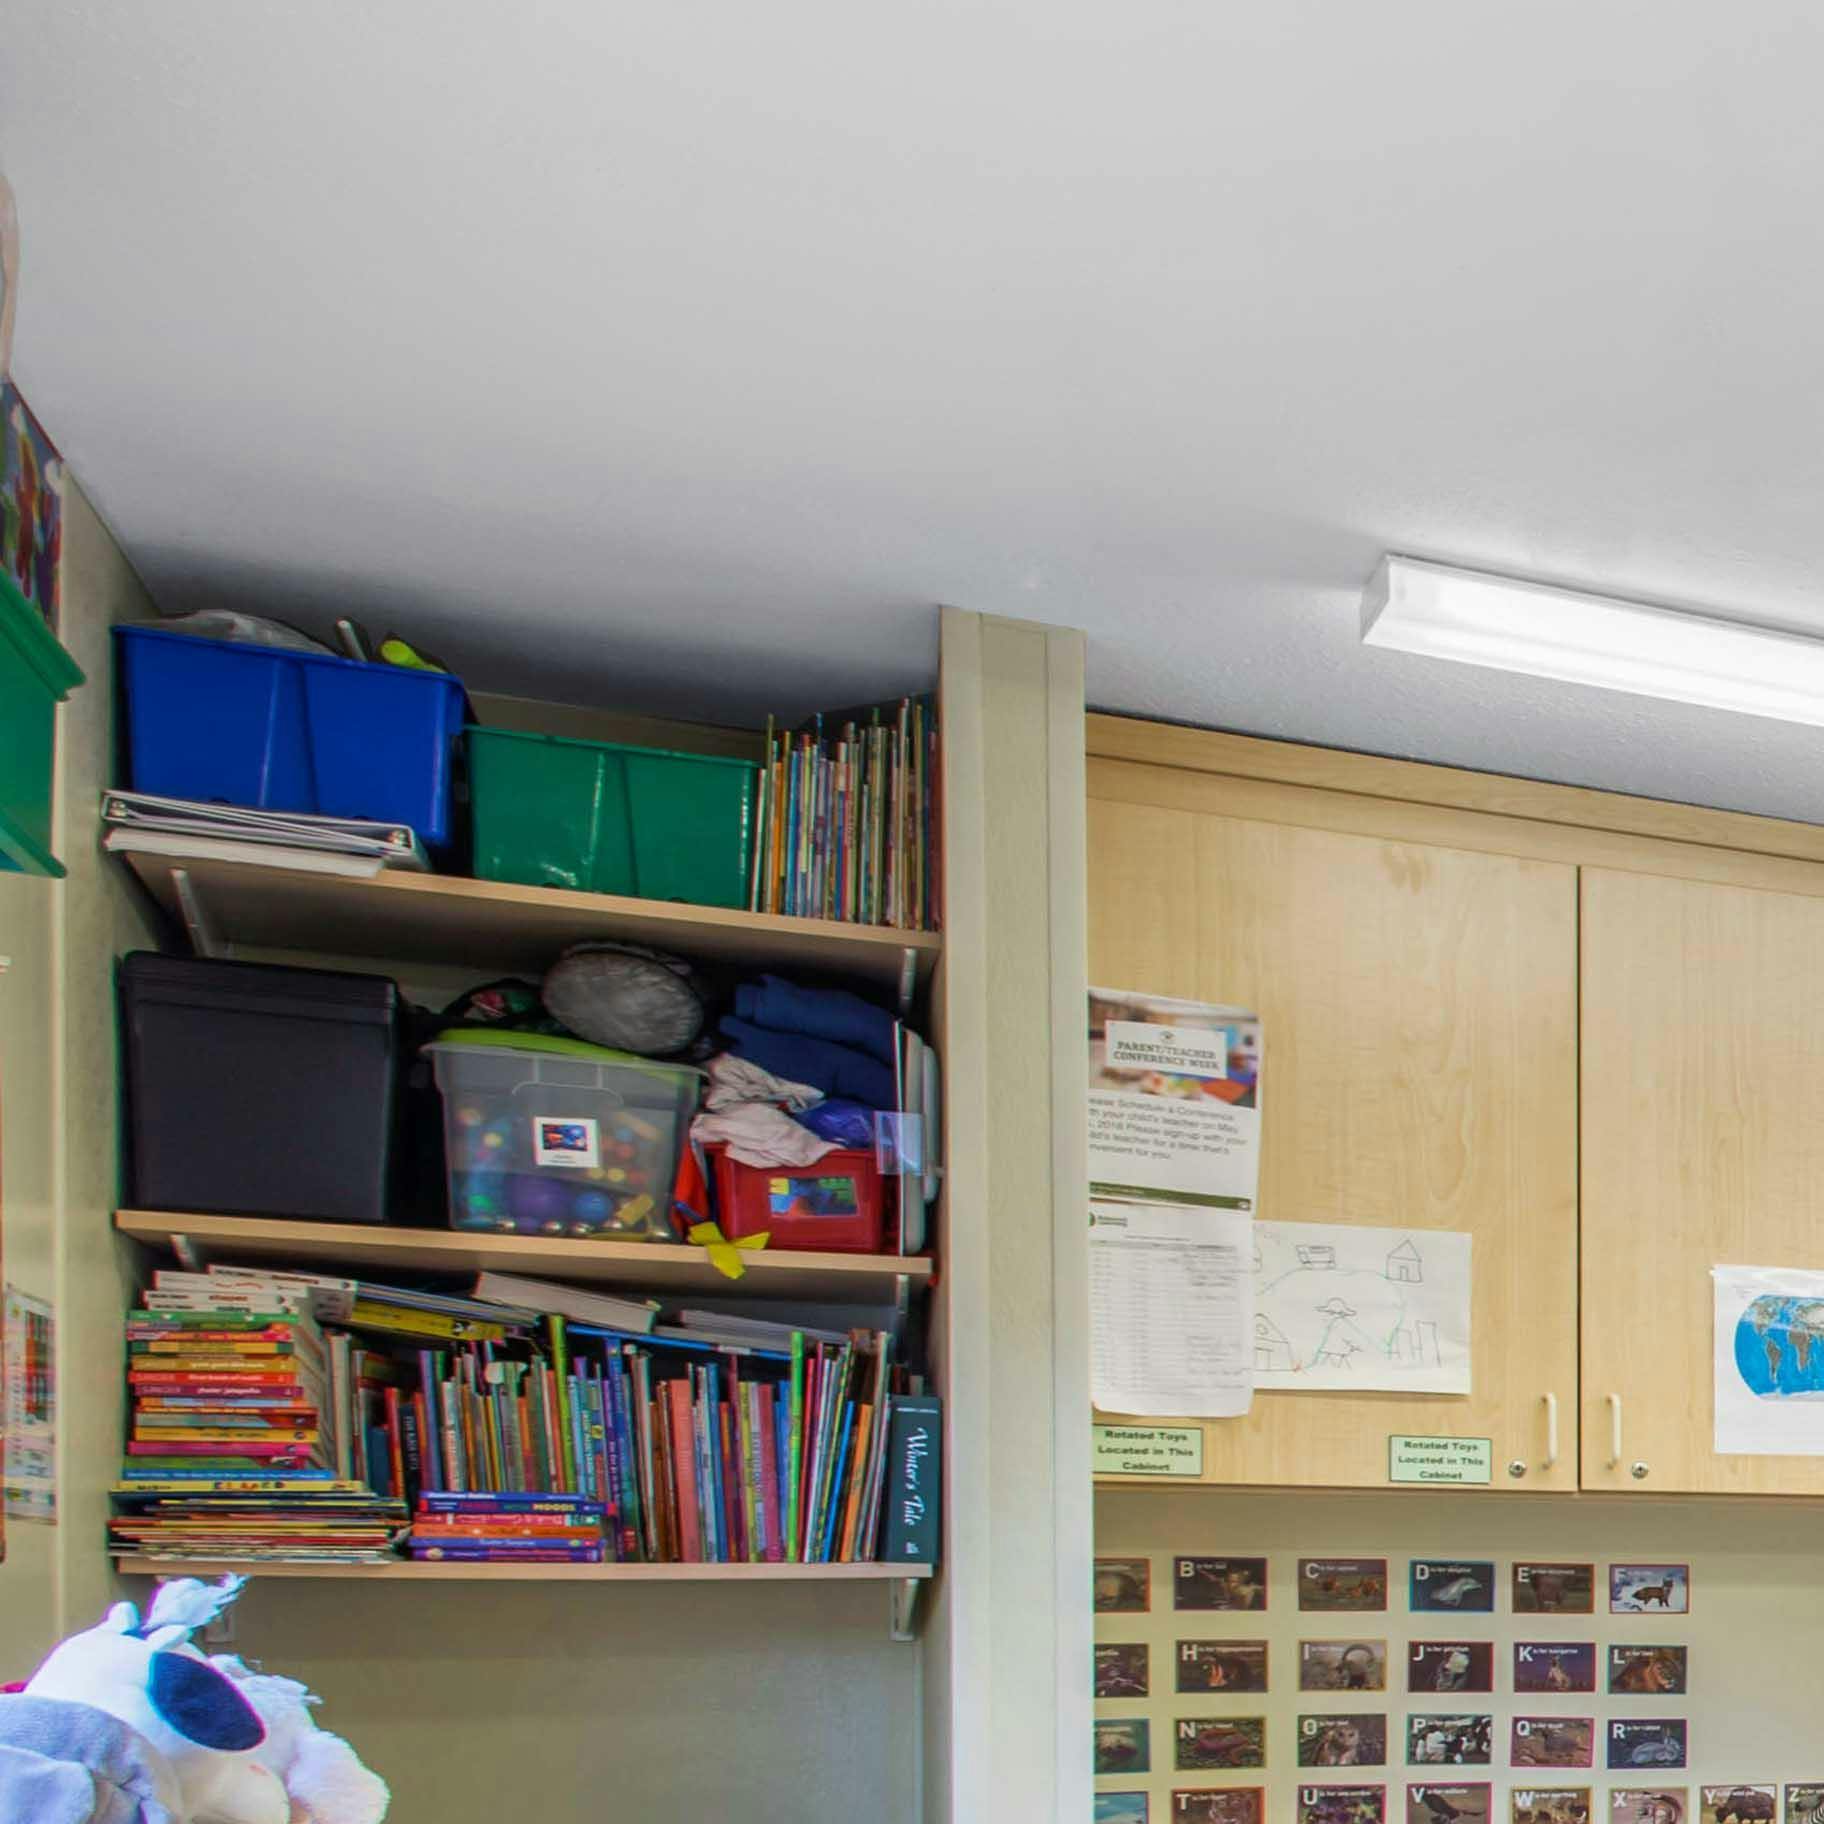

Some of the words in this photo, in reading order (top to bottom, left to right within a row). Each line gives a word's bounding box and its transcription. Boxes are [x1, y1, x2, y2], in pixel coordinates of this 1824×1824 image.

[1113, 1050, 1185, 1066] CONFERENCE
[1104, 1430, 1155, 1441] Rotated
[1157, 1431, 1189, 1443] Toys
[1097, 1445, 1151, 1457] Located
[1167, 1447, 1195, 1458] This
[1404, 1441, 1450, 1452] Rotated
[1452, 1442, 1479, 1452] Toys
[905, 1428, 930, 1491] Winter's
[1122, 1460, 1172, 1473] Cabinet
[1398, 1454, 1446, 1466] Located
[1460, 1457, 1485, 1467] This
[1419, 1469, 1463, 1480] Cabinet
[902, 1495, 926, 1526] Tale
[1180, 1561, 1194, 1577] B
[1305, 1563, 1320, 1578] C
[1416, 1565, 1430, 1580] D
[1517, 1567, 1530, 1582] E
[1614, 1568, 1626, 1583] F
[1182, 1644, 1198, 1661] H
[1412, 1645, 1424, 1661] J
[1519, 1646, 1533, 1661] K
[1613, 1648, 1625, 1664] L
[1179, 1722, 1196, 1738] N
[1303, 1719, 1317, 1735] O
[1413, 1718, 1426, 1734] P
[1516, 1720, 1531, 1736] Q
[1612, 1723, 1625, 1739] R
[1176, 1793, 1191, 1810] T
[1302, 1788, 1318, 1805] U
[1411, 1787, 1425, 1803] V
[1514, 1791, 1534, 1808] W
[1614, 1792, 1626, 1808] X
[1789, 1787, 1800, 1802] Z
